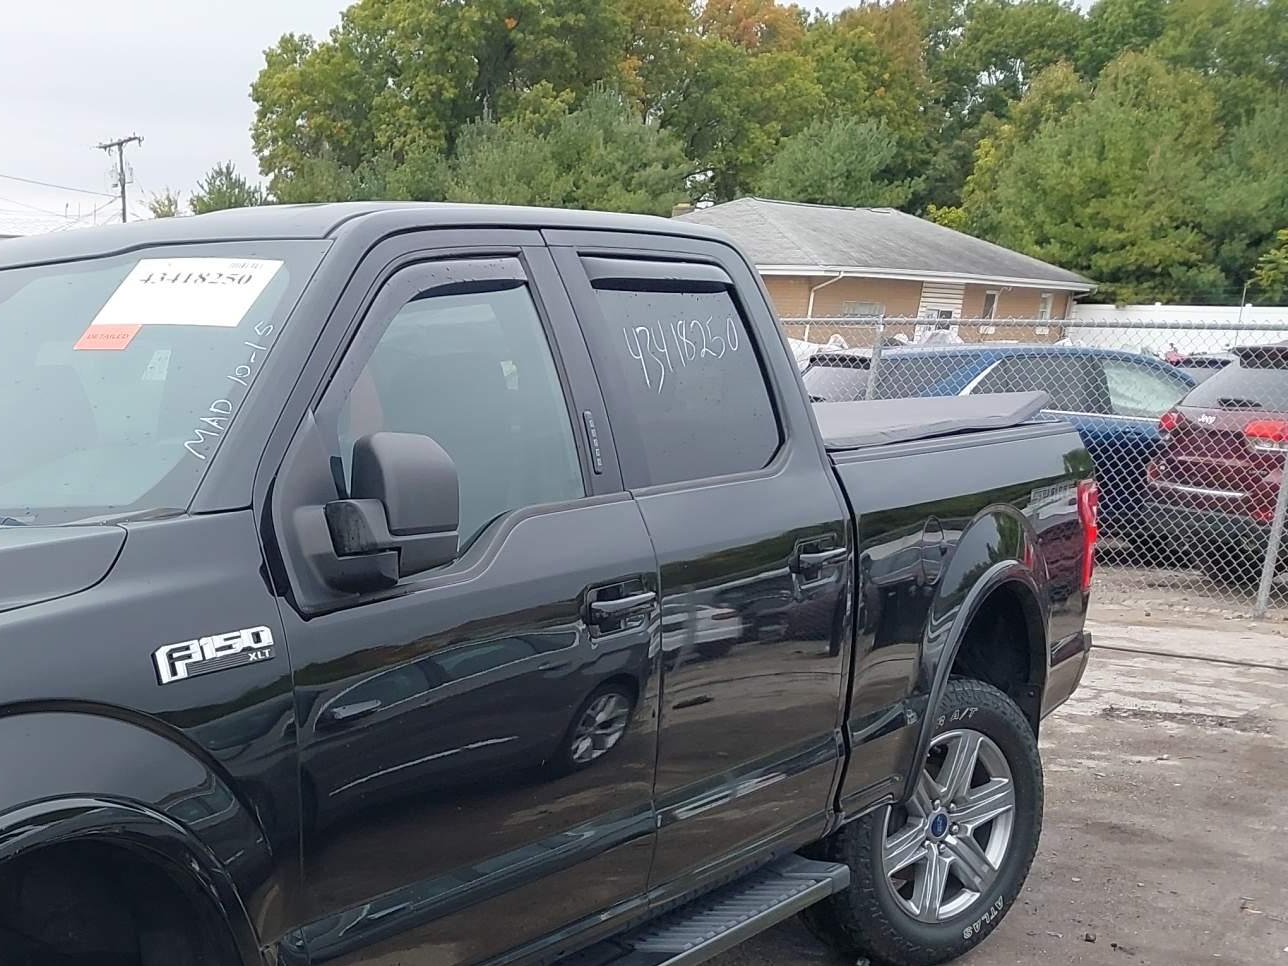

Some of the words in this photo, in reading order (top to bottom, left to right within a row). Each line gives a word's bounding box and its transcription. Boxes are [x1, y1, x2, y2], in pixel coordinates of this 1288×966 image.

[139, 272, 253, 285] 43418250
[623, 315, 739, 394] 43418250
[184, 399, 233, 460] MAD
[227, 320, 274, 386] 10-15
[1198, 413, 1216, 425] Jeep
[248, 648, 272, 662] XLT
[950, 707, 978, 722] A/T
[963, 895, 1004, 939] ATLAS
